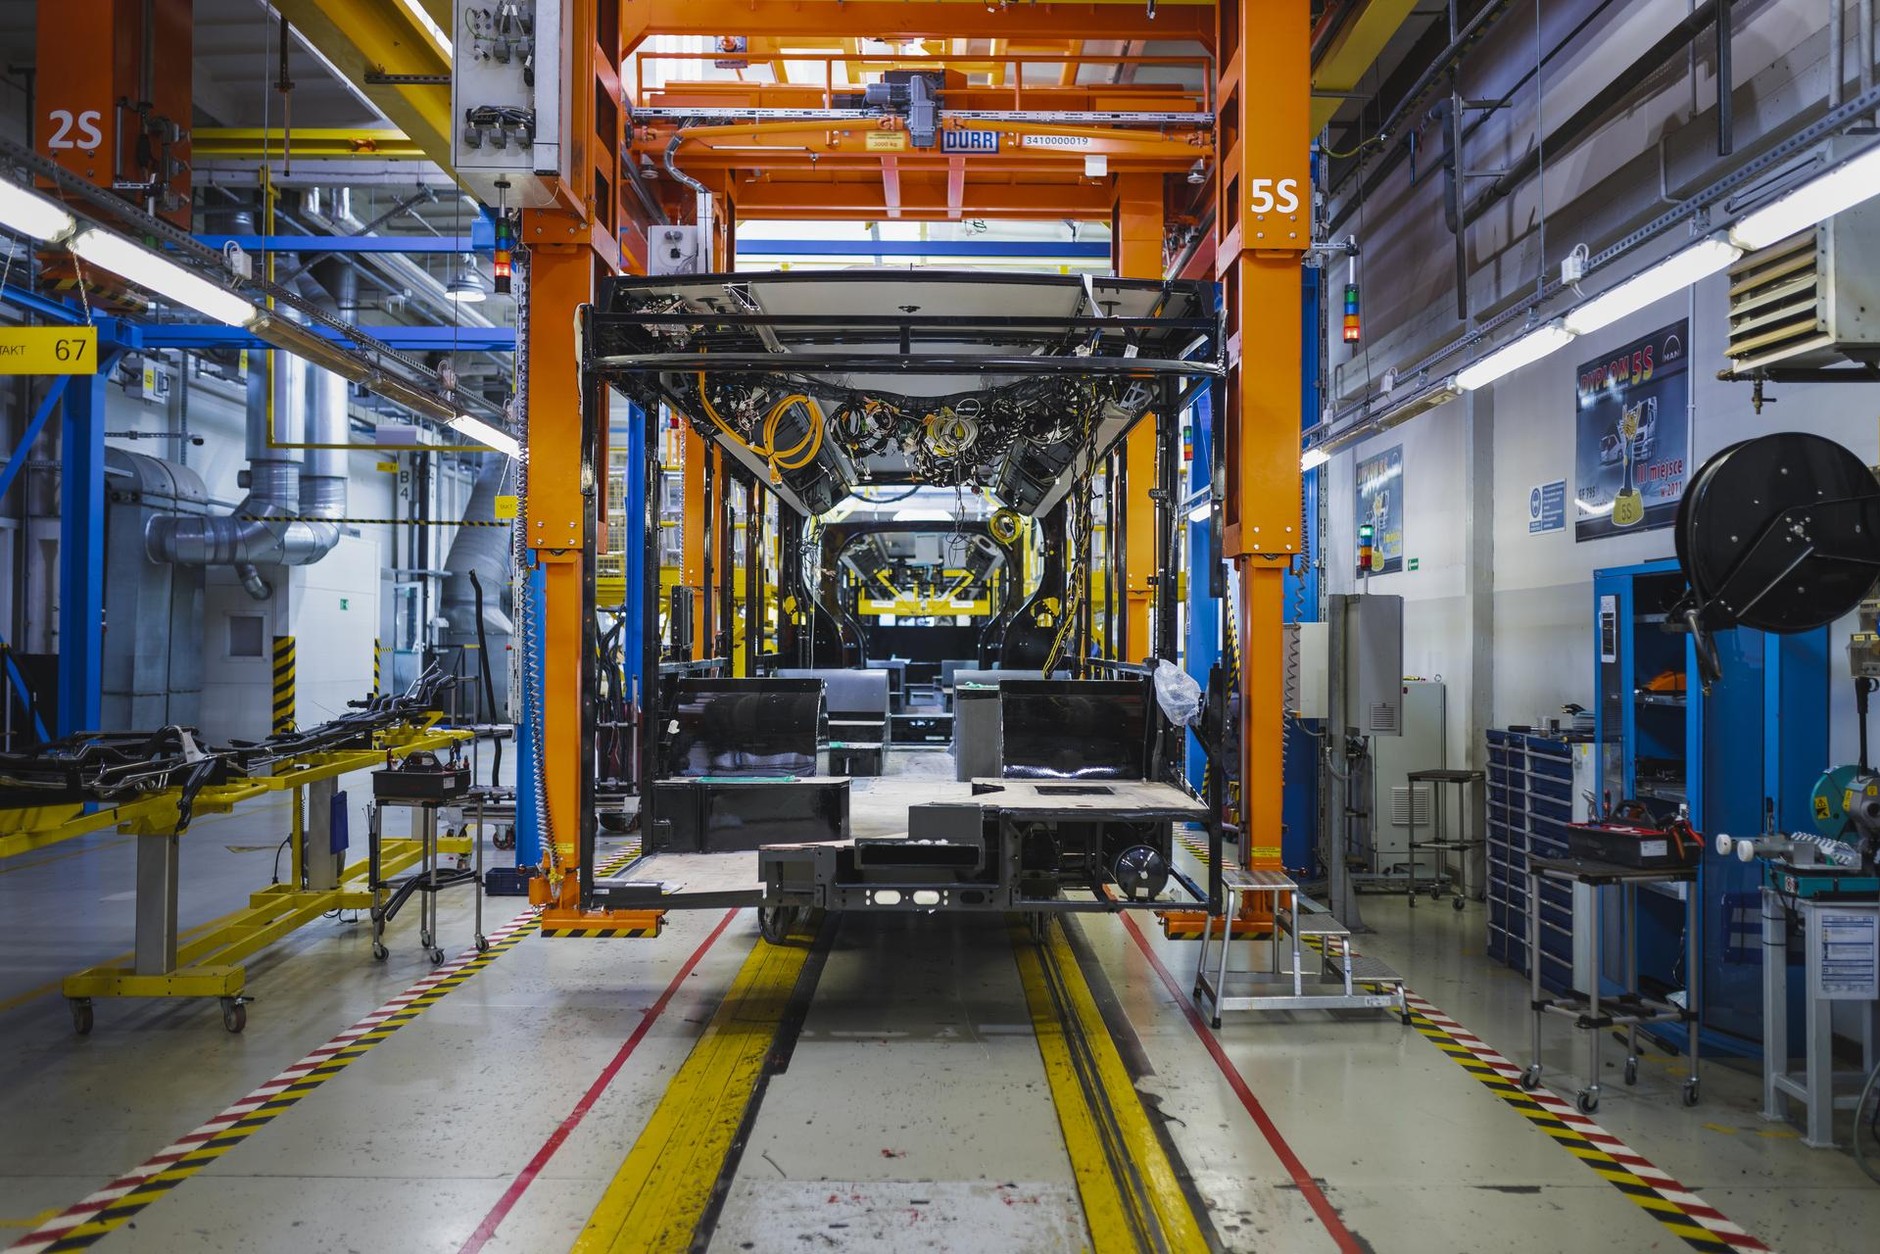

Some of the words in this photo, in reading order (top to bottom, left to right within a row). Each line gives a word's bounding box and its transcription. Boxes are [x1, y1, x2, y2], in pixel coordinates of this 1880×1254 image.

[48, 109, 102, 150] 2S
[1251, 178, 1299, 213] 5S
[55, 339, 87, 361] 67
[1664, 349, 1680, 361] MAN
[1632, 345, 1653, 385] 5S
[1649, 459, 1683, 481] miejsce
[1621, 503, 1632, 520] 5S
